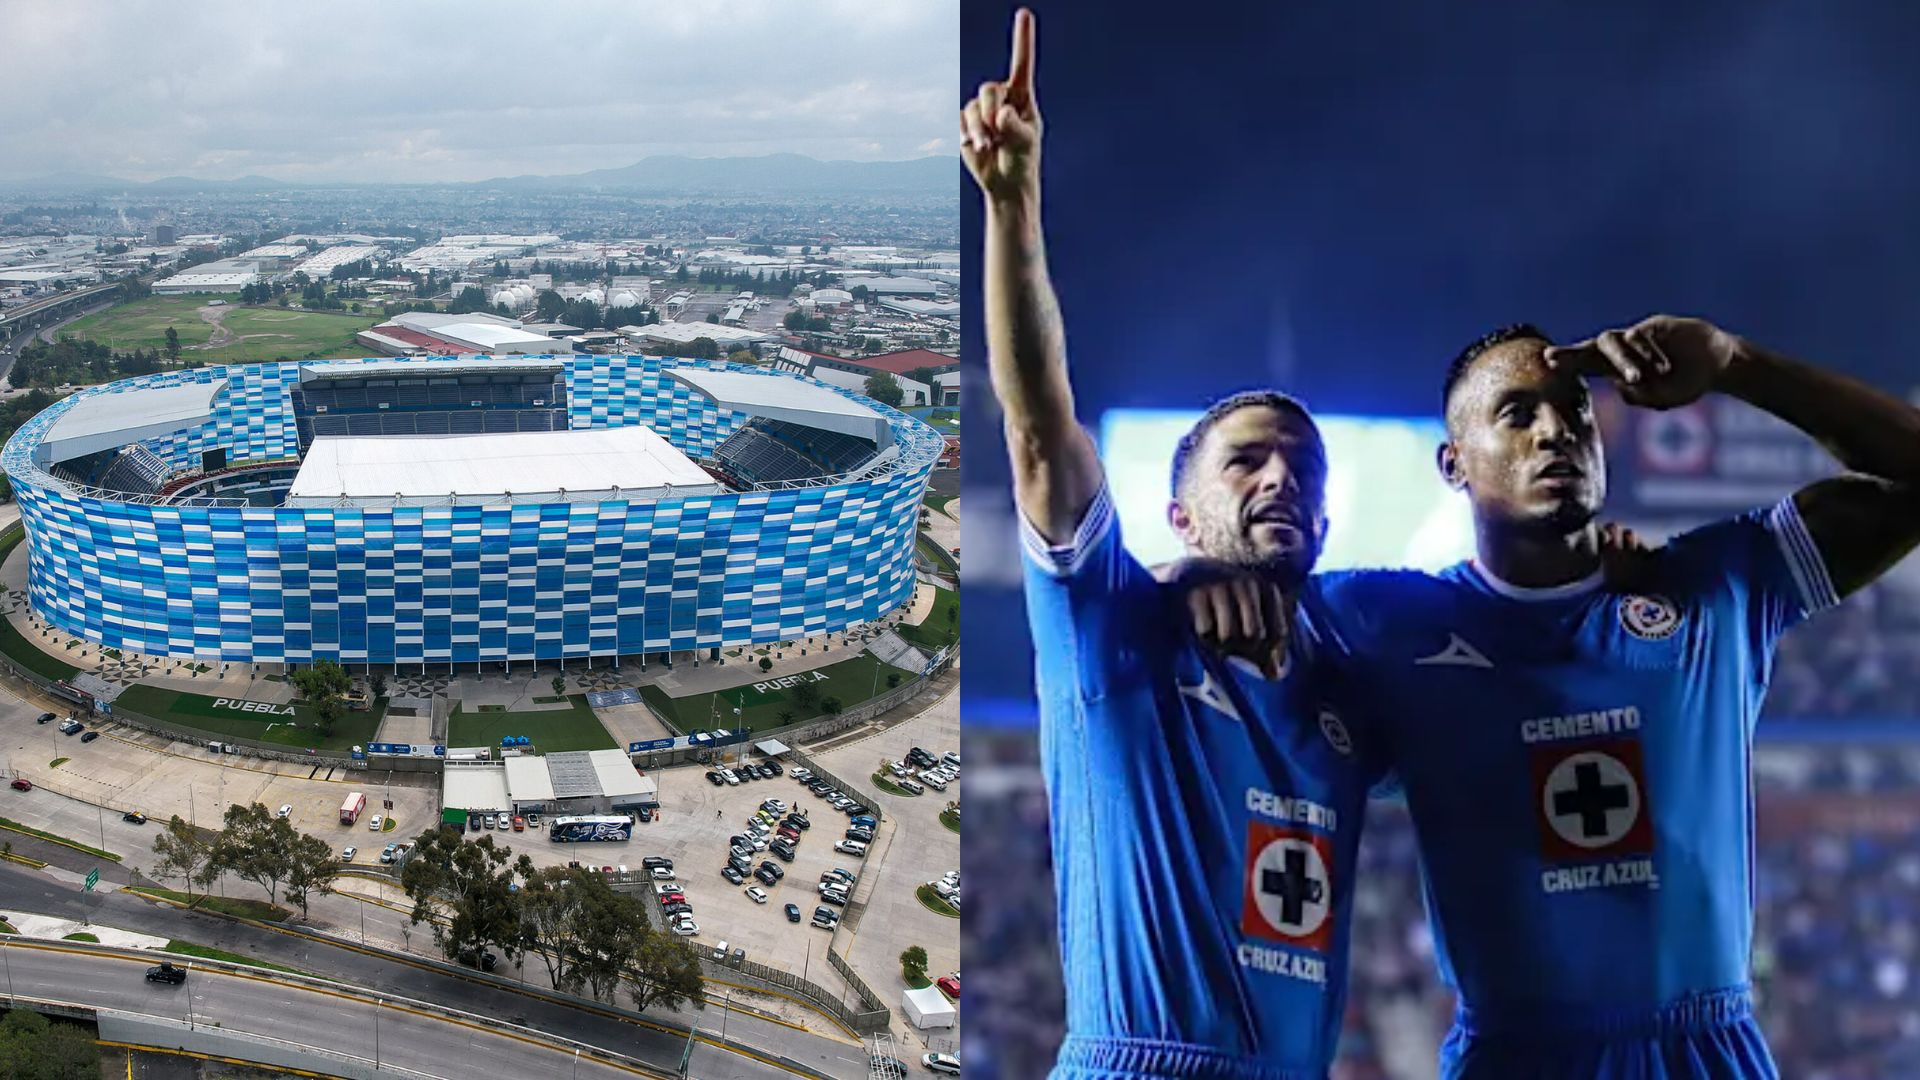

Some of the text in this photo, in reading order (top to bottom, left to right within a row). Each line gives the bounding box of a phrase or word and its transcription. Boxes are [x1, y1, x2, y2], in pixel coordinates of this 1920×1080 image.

[212, 698, 297, 716] PUEBLA
[1521, 706, 1640, 743] CEMENTO
[1245, 787, 1337, 832] CEMENTO
[1541, 860, 1659, 893] CRUZ AZUL
[1237, 943, 1328, 984] CRUZ AZUL
